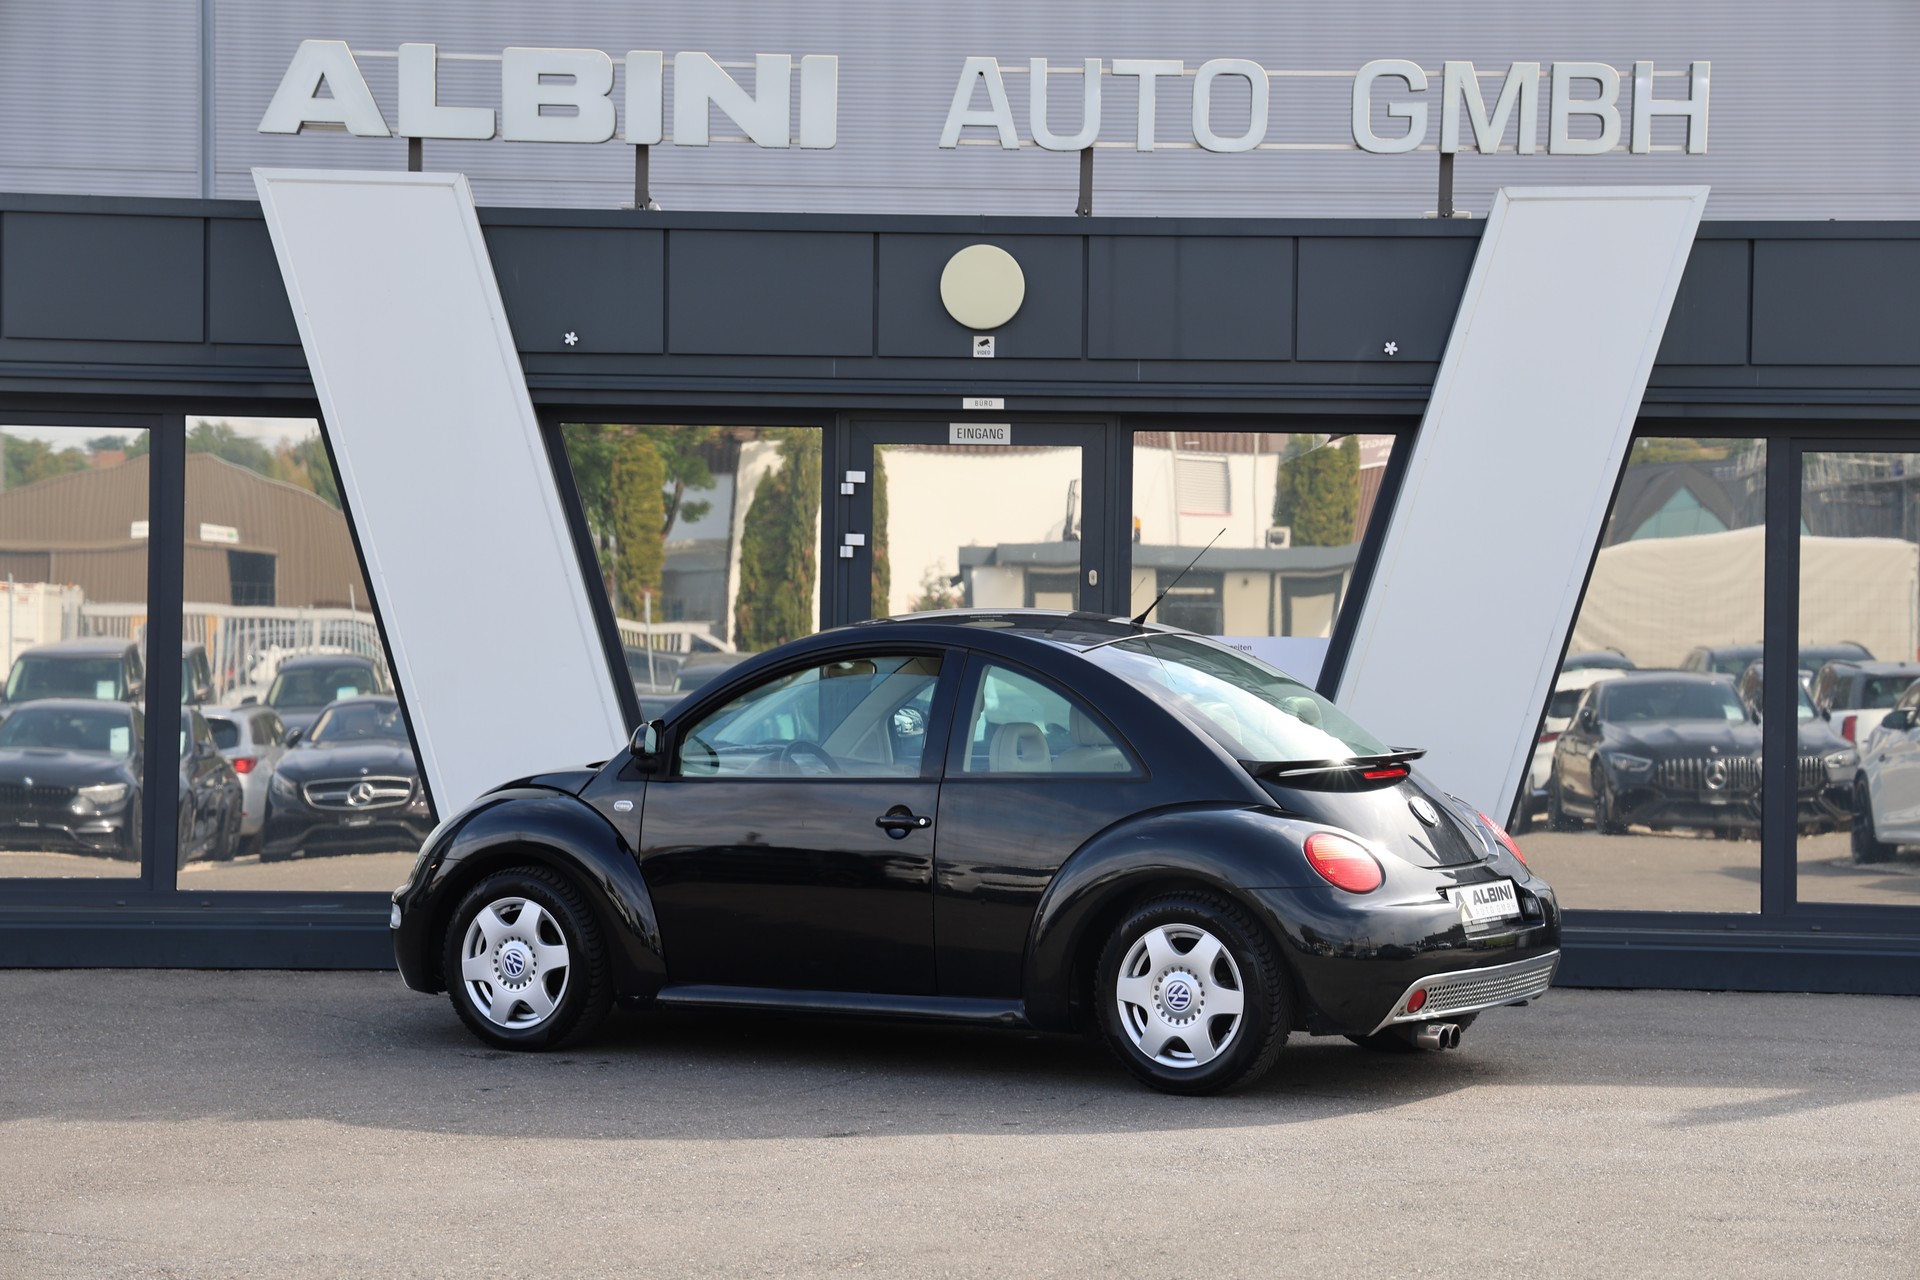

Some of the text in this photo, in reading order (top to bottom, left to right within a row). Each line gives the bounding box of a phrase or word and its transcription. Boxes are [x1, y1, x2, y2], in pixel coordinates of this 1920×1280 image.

[257, 39, 1710, 155] ALBINI AUTO GMBH
[957, 428, 1004, 439] EINGANG
[1473, 885, 1512, 905] ALBINI
